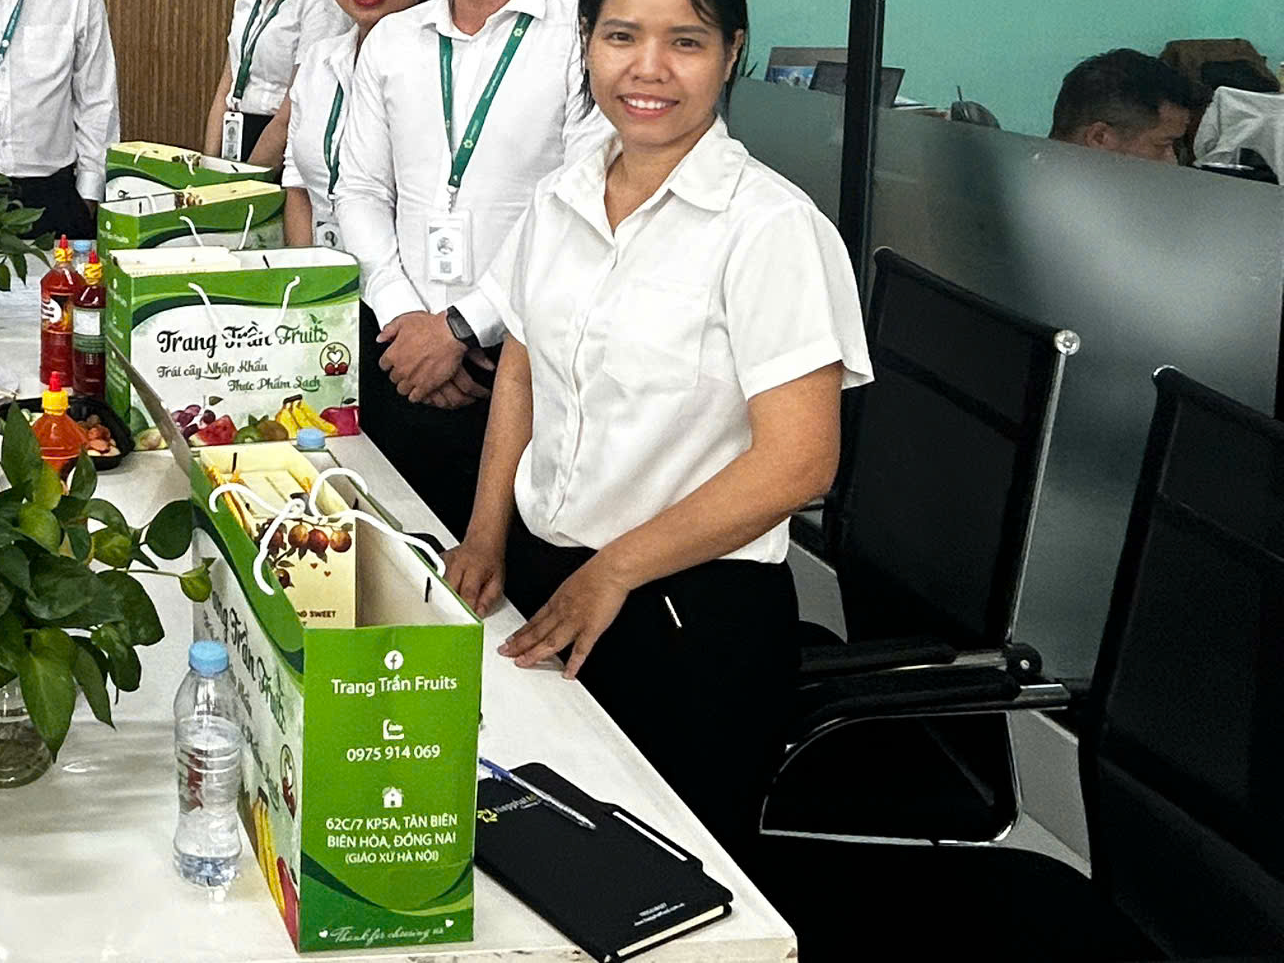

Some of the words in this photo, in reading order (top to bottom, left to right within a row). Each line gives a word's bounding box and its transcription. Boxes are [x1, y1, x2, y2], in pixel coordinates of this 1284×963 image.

[156, 330, 218, 359] Trang
[274, 321, 329, 345] Fruits
[156, 365, 182, 380] Trái
[183, 364, 203, 380] cây
[331, 678, 376, 697] Trang
[378, 674, 411, 692] Trần
[415, 675, 458, 692] Fruits
[346, 747, 381, 763] 0975
[384, 745, 411, 760] 914
[413, 745, 441, 759] 069
[325, 816, 364, 832] 62C/7
[366, 816, 401, 832] KP5A,
[403, 815, 428, 829] TÂN
[430, 812, 458, 827] BIÊN
[327, 833, 357, 848] BIÊN
[359, 833, 391, 849] HÒA,
[393, 831, 432, 848] ĐỒNG
[434, 831, 457, 845] NAI
[344, 851, 377, 865] (GIÁO
[397, 850, 414, 862] HÀ
[415, 850, 440, 864] NỘI)
